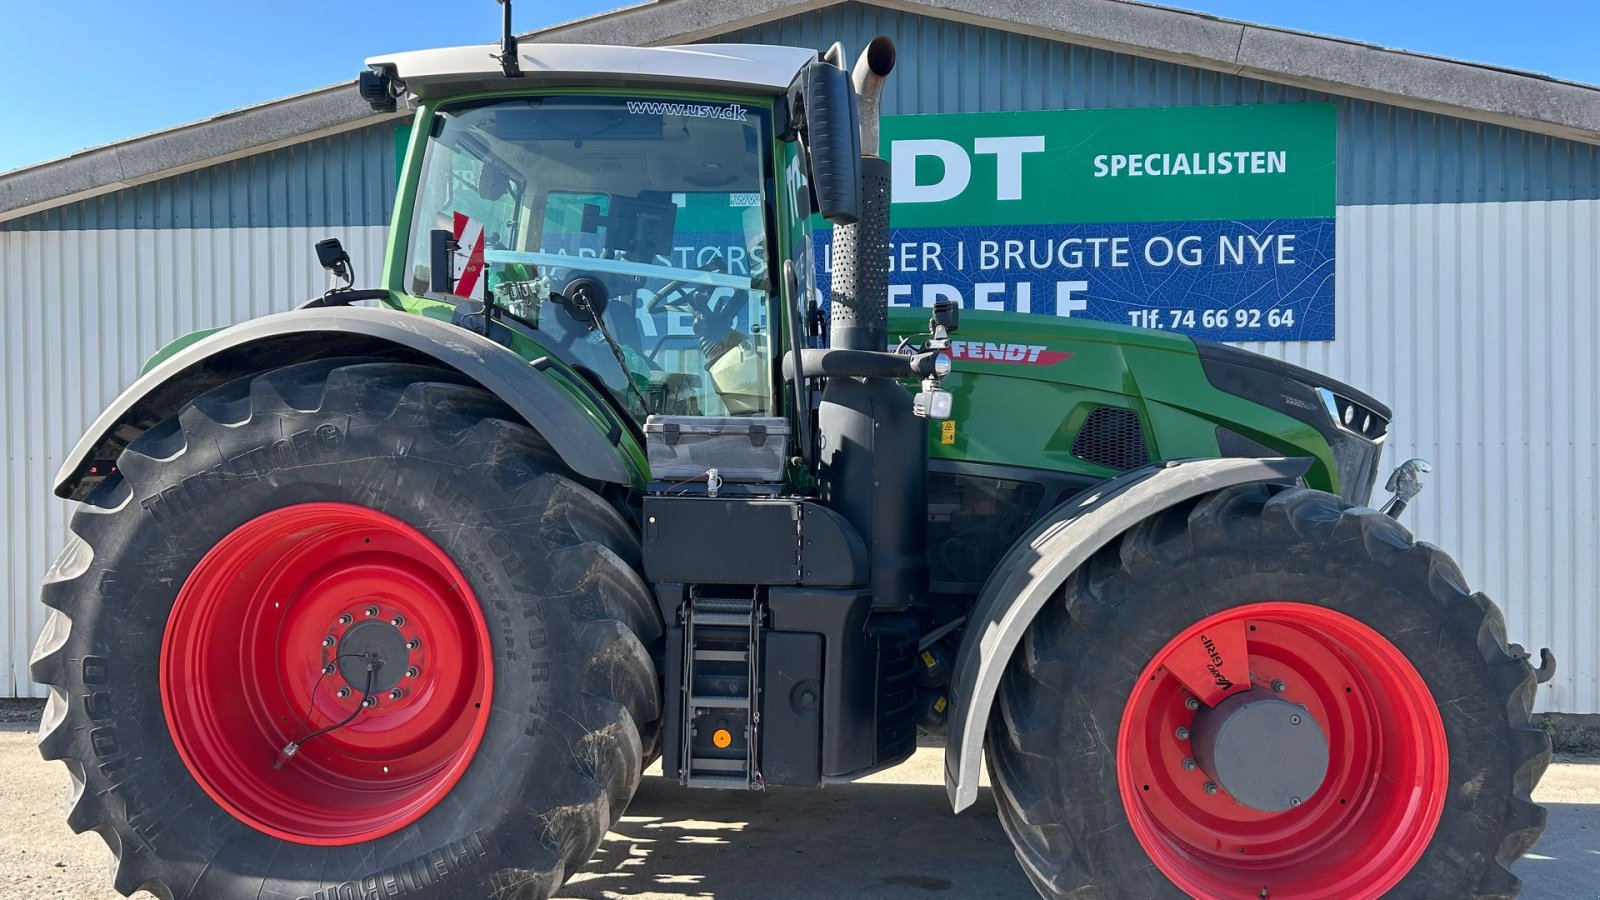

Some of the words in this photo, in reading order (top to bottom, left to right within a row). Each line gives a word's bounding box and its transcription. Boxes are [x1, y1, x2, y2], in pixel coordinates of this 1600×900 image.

[627, 101, 747, 121] www.usv.dk
[891, 136, 1045, 206] DT
[1094, 151, 1287, 177] SPECIALISTEN
[958, 242, 963, 270] I
[980, 237, 1130, 269] BRUGTE
[1144, 235, 1203, 266] OG
[1219, 234, 1296, 264] NYE
[1127, 309, 1164, 329] Tlf.
[1170, 309, 1196, 328] 74
[1202, 309, 1228, 328] 66
[1235, 309, 1261, 328] 92
[1267, 308, 1294, 328] 64
[949, 341, 1047, 363] FENDT
